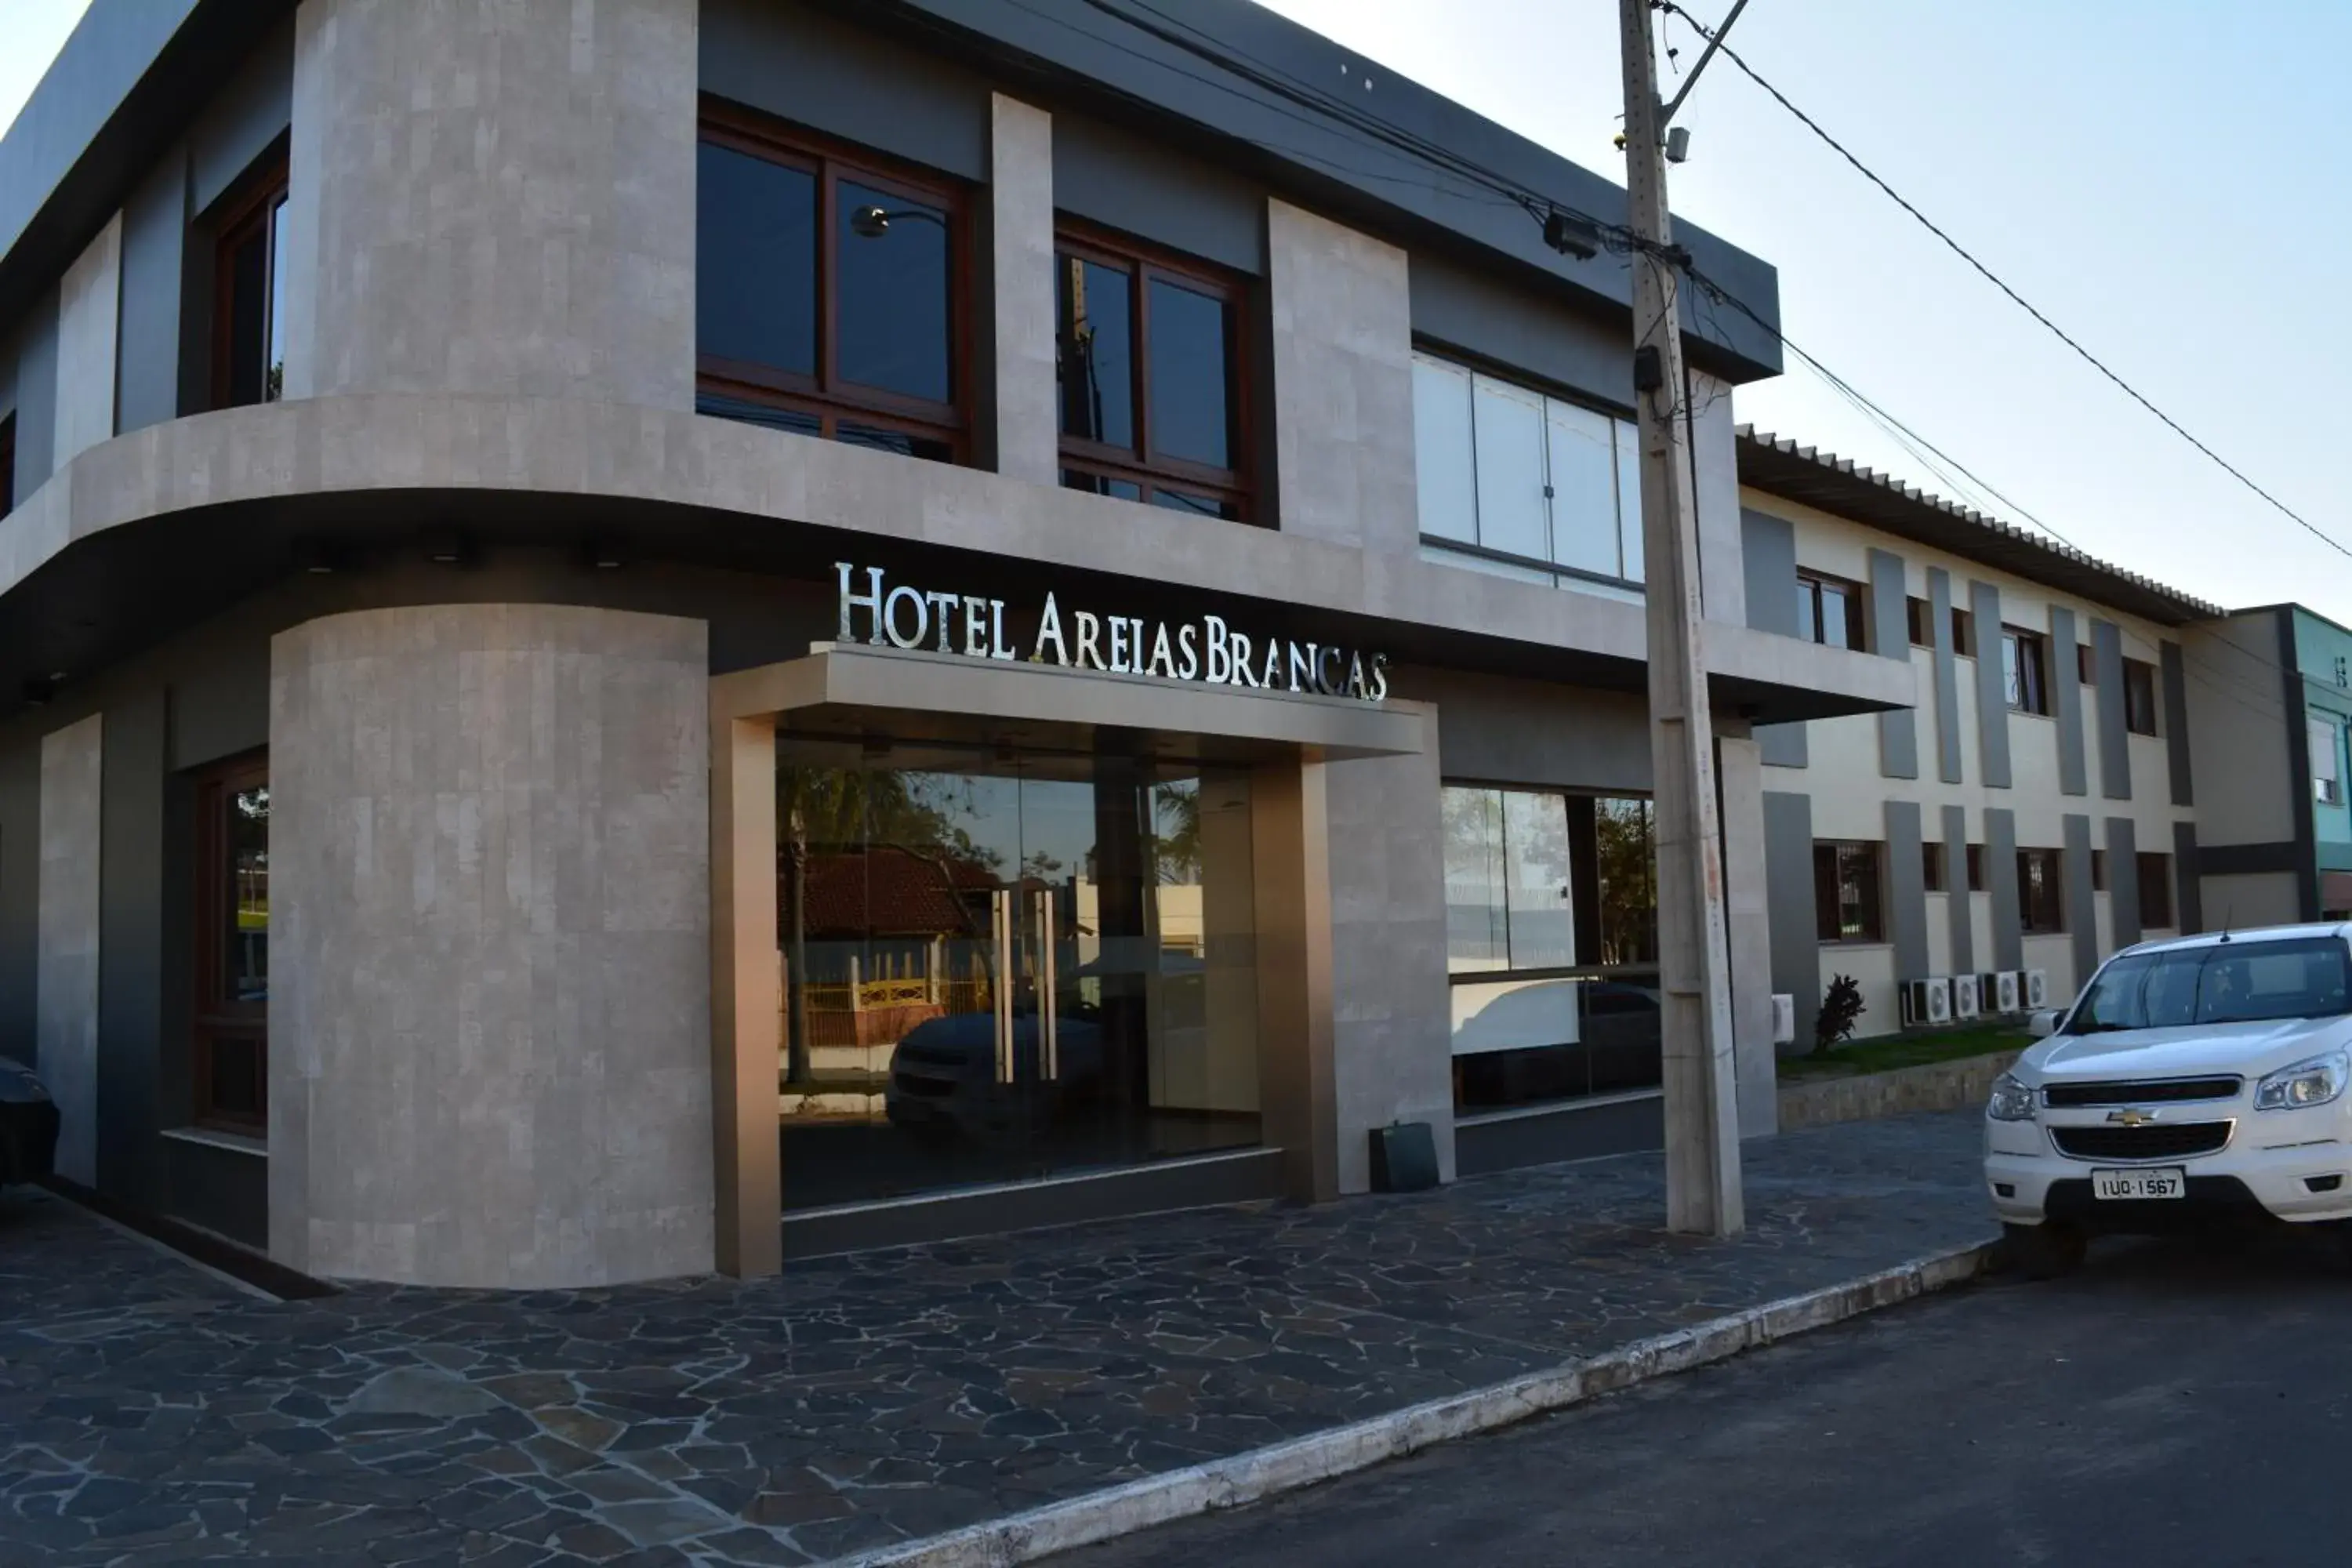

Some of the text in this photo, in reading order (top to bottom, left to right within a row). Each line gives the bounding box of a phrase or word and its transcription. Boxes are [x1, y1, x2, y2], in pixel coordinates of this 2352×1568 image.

[834, 561, 1388, 702] HOTEL AREIAS BRANCAS
